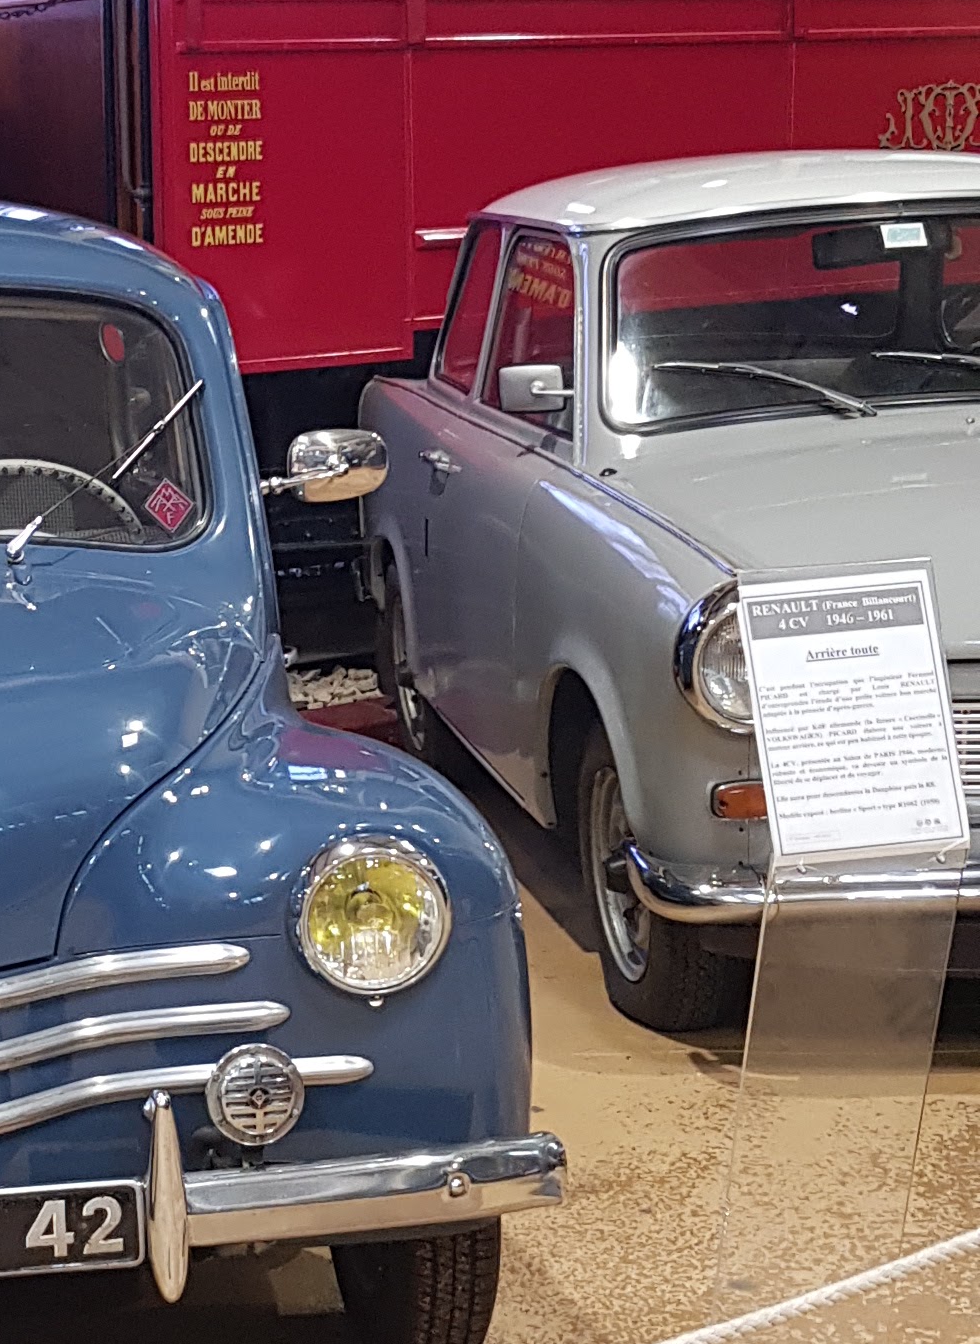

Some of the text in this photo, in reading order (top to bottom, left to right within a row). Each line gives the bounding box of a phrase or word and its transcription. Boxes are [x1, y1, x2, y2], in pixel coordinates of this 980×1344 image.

[200, 78, 215, 92] est
[217, 69, 259, 91] interdit
[189, 99, 261, 121] DE MONTER
[210, 124, 242, 136] OU DE
[189, 141, 263, 163] DESCENDRE
[216, 166, 236, 178] EN
[192, 182, 261, 203] MARCHE
[200, 208, 224, 219] SOUS
[192, 224, 263, 247] D'AMENDE
[751, 599, 819, 616] RENAULT
[821, 598, 858, 611] (France
[777, 618, 786, 630] 4
[787, 616, 809, 629] CV
[825, 612, 854, 625] 1946
[867, 608, 893, 622] 1961
[804, 644, 879, 661] Arrière toute
[25, 1196, 125, 1258] 42
